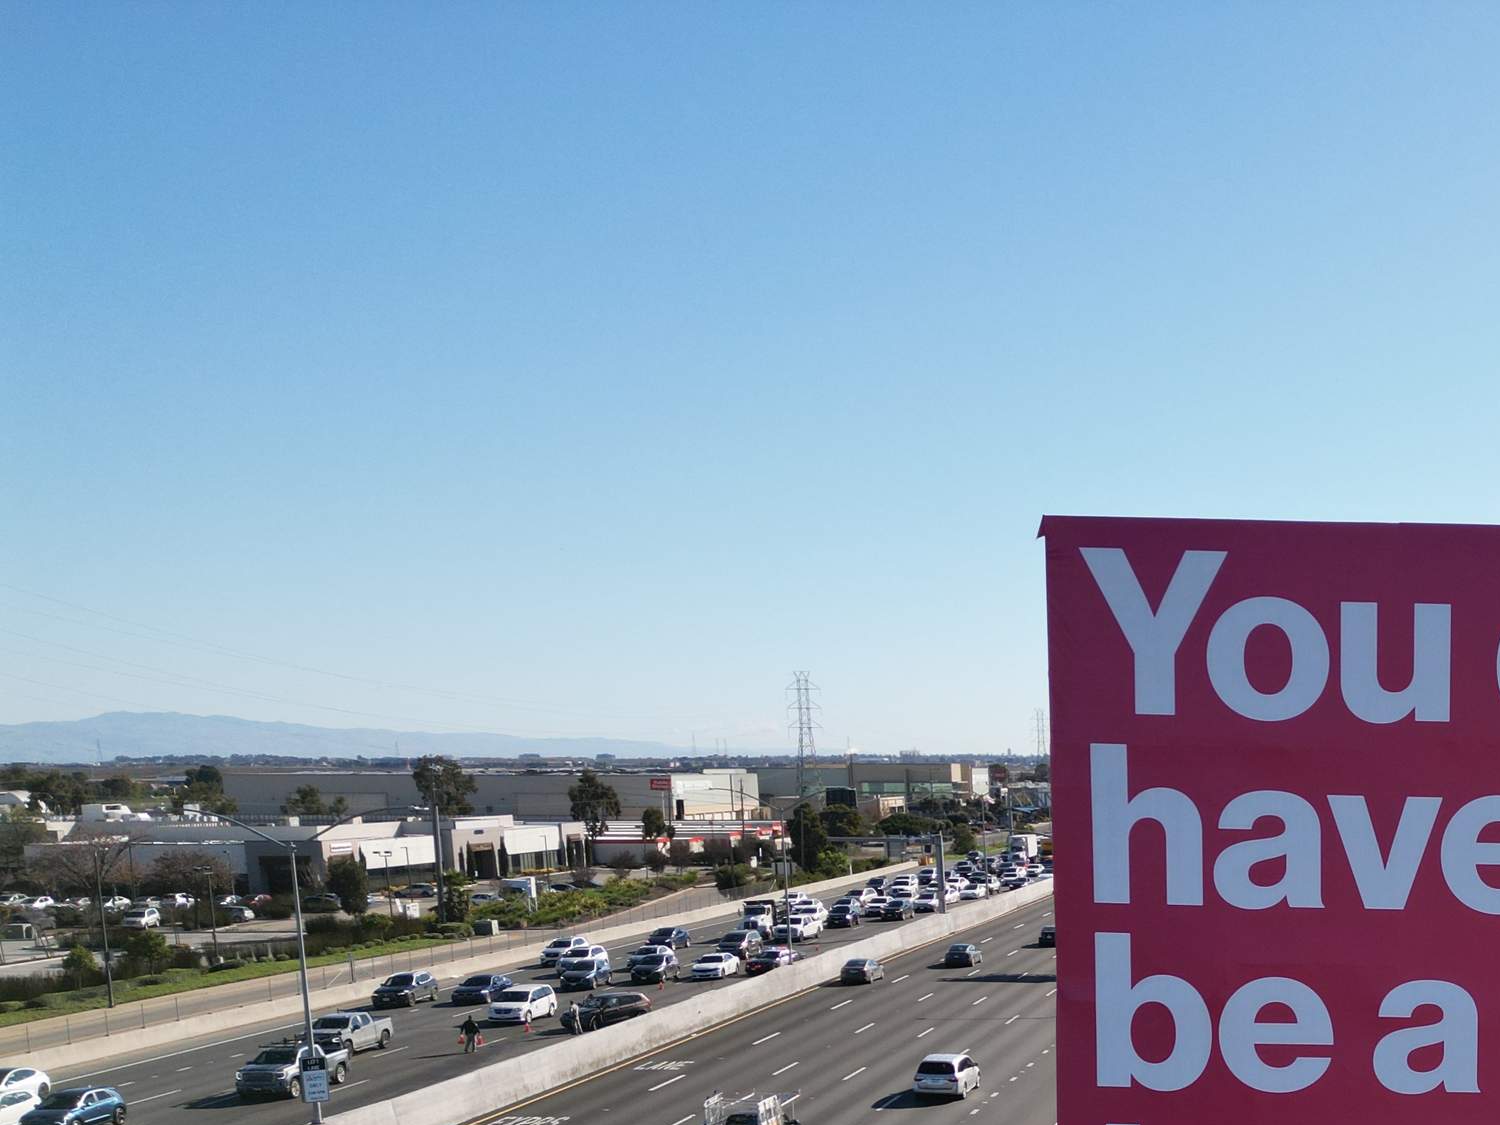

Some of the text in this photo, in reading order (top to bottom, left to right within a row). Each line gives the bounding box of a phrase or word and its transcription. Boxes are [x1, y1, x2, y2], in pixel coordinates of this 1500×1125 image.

[1079, 547, 1452, 724] You
[633, 1060, 696, 1071] LANE
[1094, 931, 1334, 1098] be
[1372, 979, 1481, 1095] a
